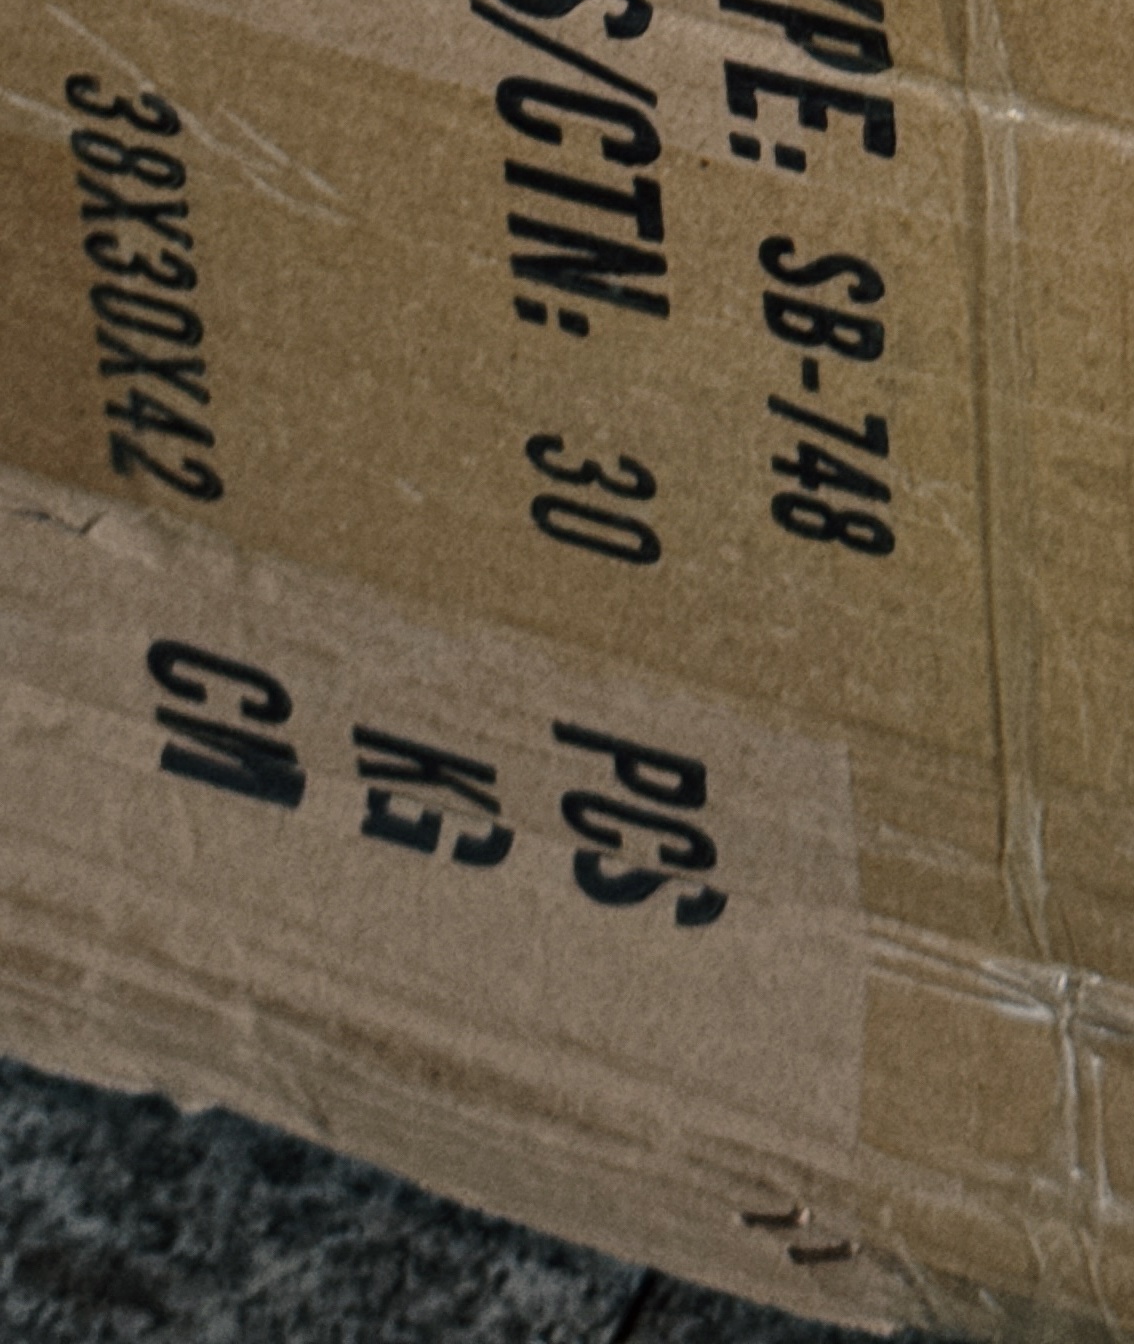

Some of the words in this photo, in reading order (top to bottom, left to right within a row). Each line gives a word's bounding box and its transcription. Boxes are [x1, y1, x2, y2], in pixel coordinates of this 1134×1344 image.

[63, 73, 225, 504] 38X30X42
[757, 235, 896, 558] SB-748
[524, 433, 663, 566] 30
[551, 720, 728, 928] PCS
